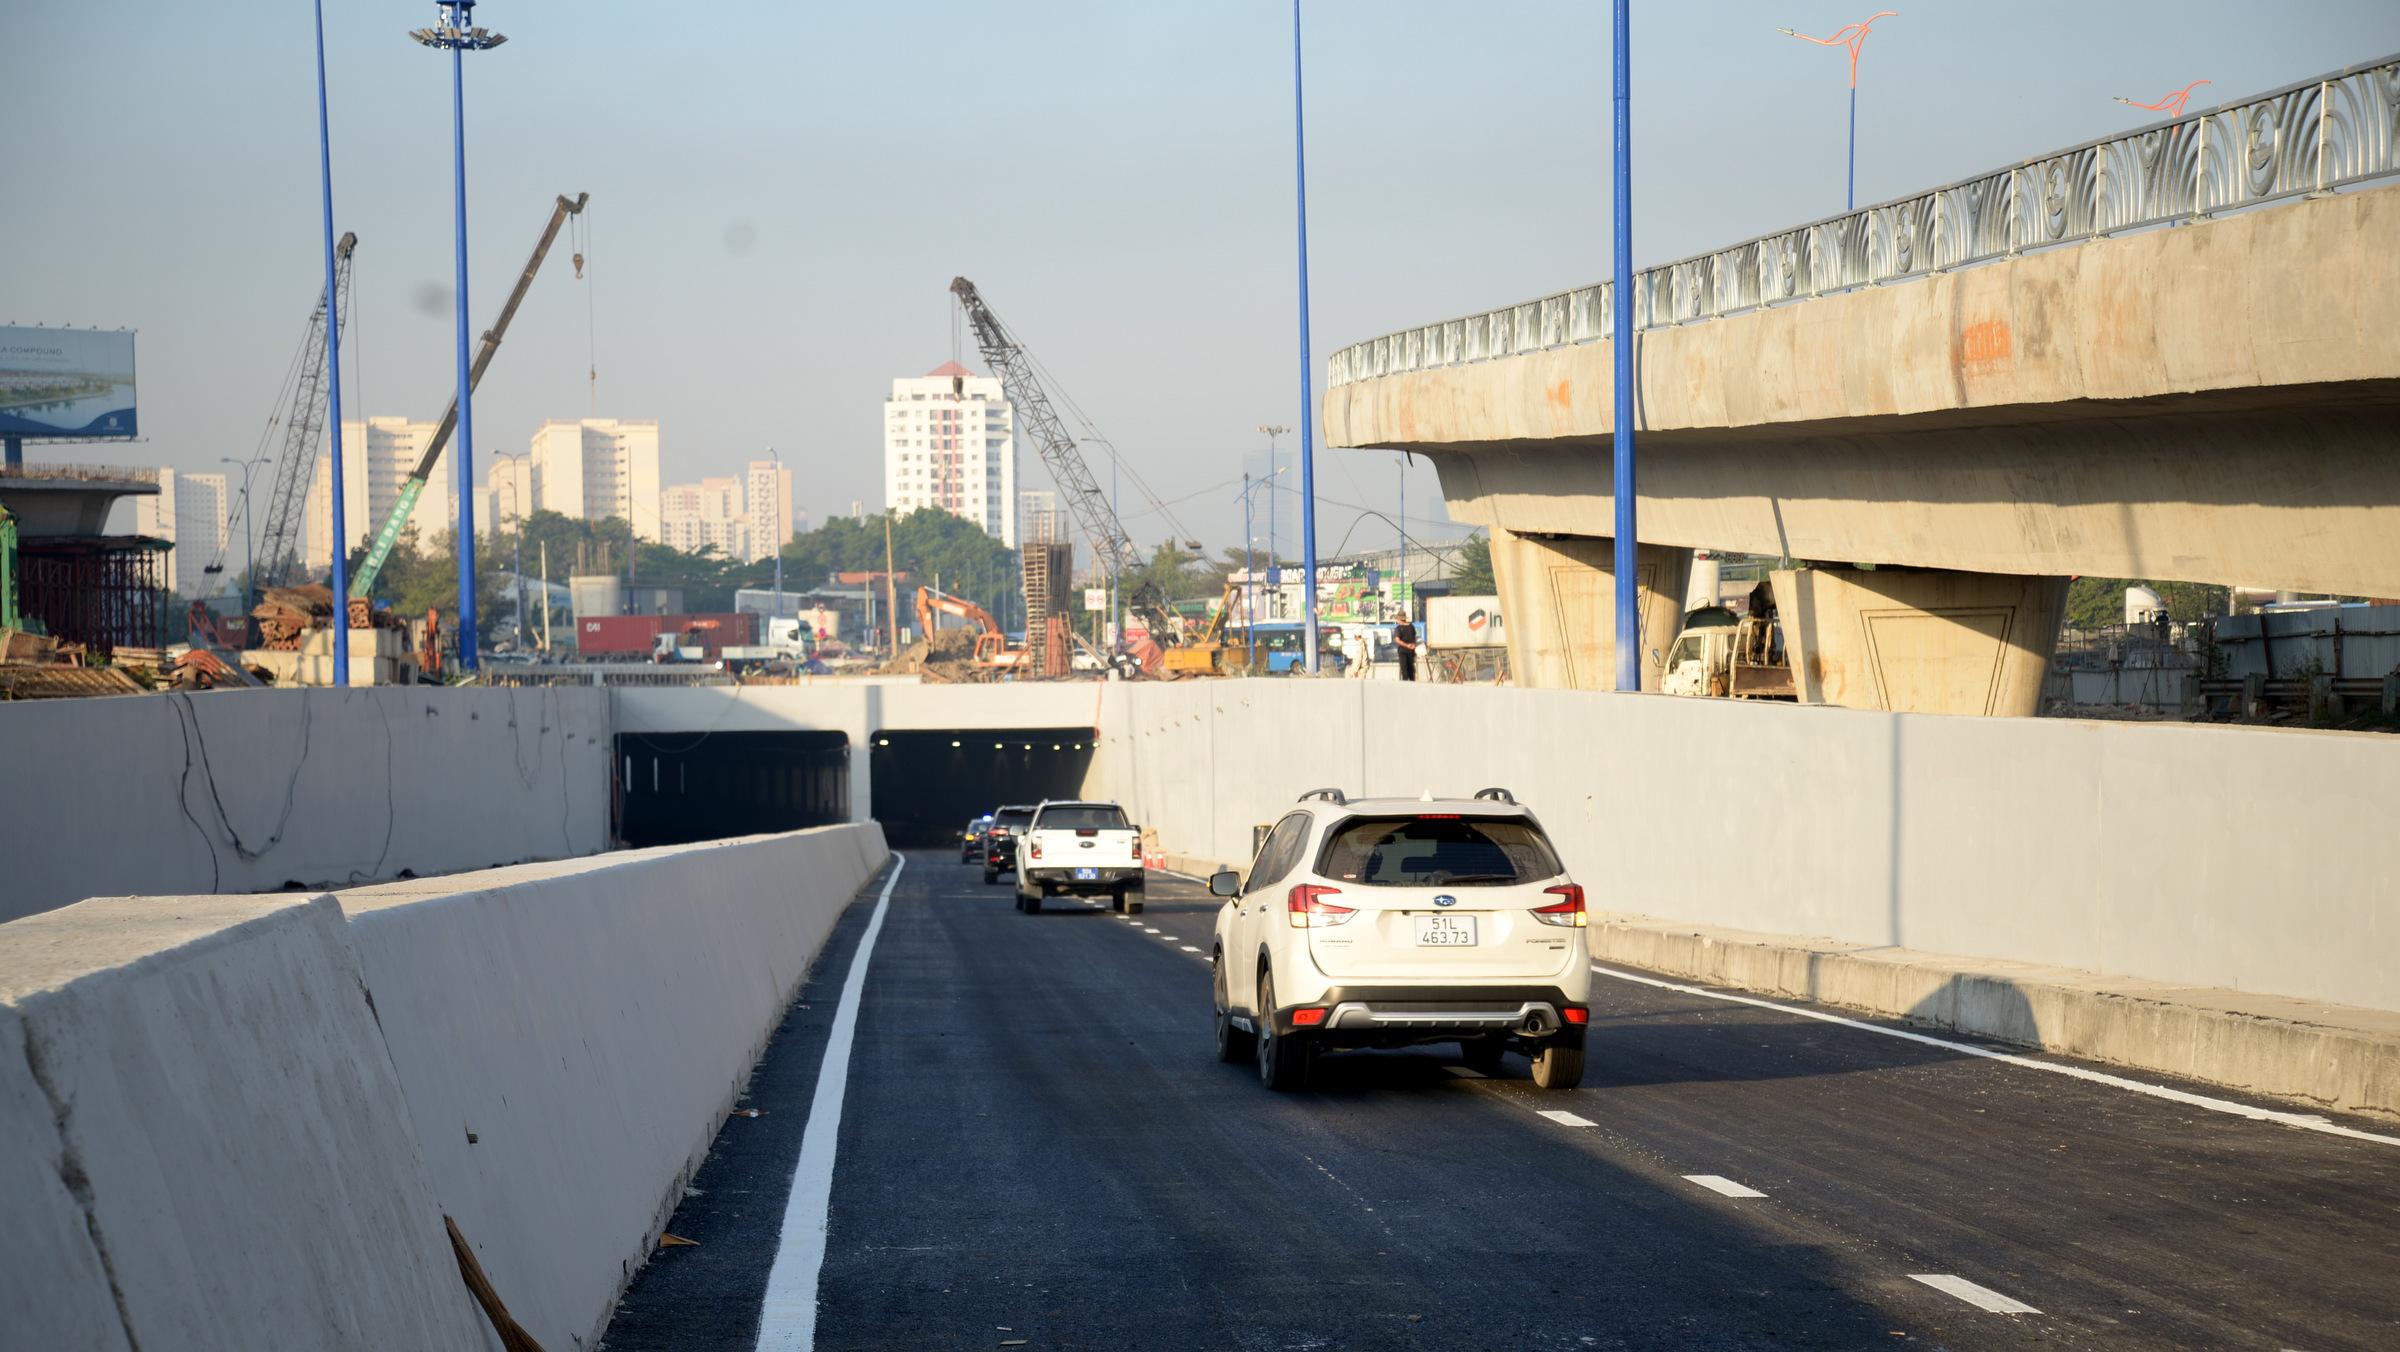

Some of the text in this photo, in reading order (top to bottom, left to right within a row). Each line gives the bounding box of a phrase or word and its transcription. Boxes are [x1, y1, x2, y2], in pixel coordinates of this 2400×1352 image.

[9, 346, 63, 356] COMPOUND
[1432, 917, 1457, 930] 51L
[1422, 931, 1469, 944] 463.73
